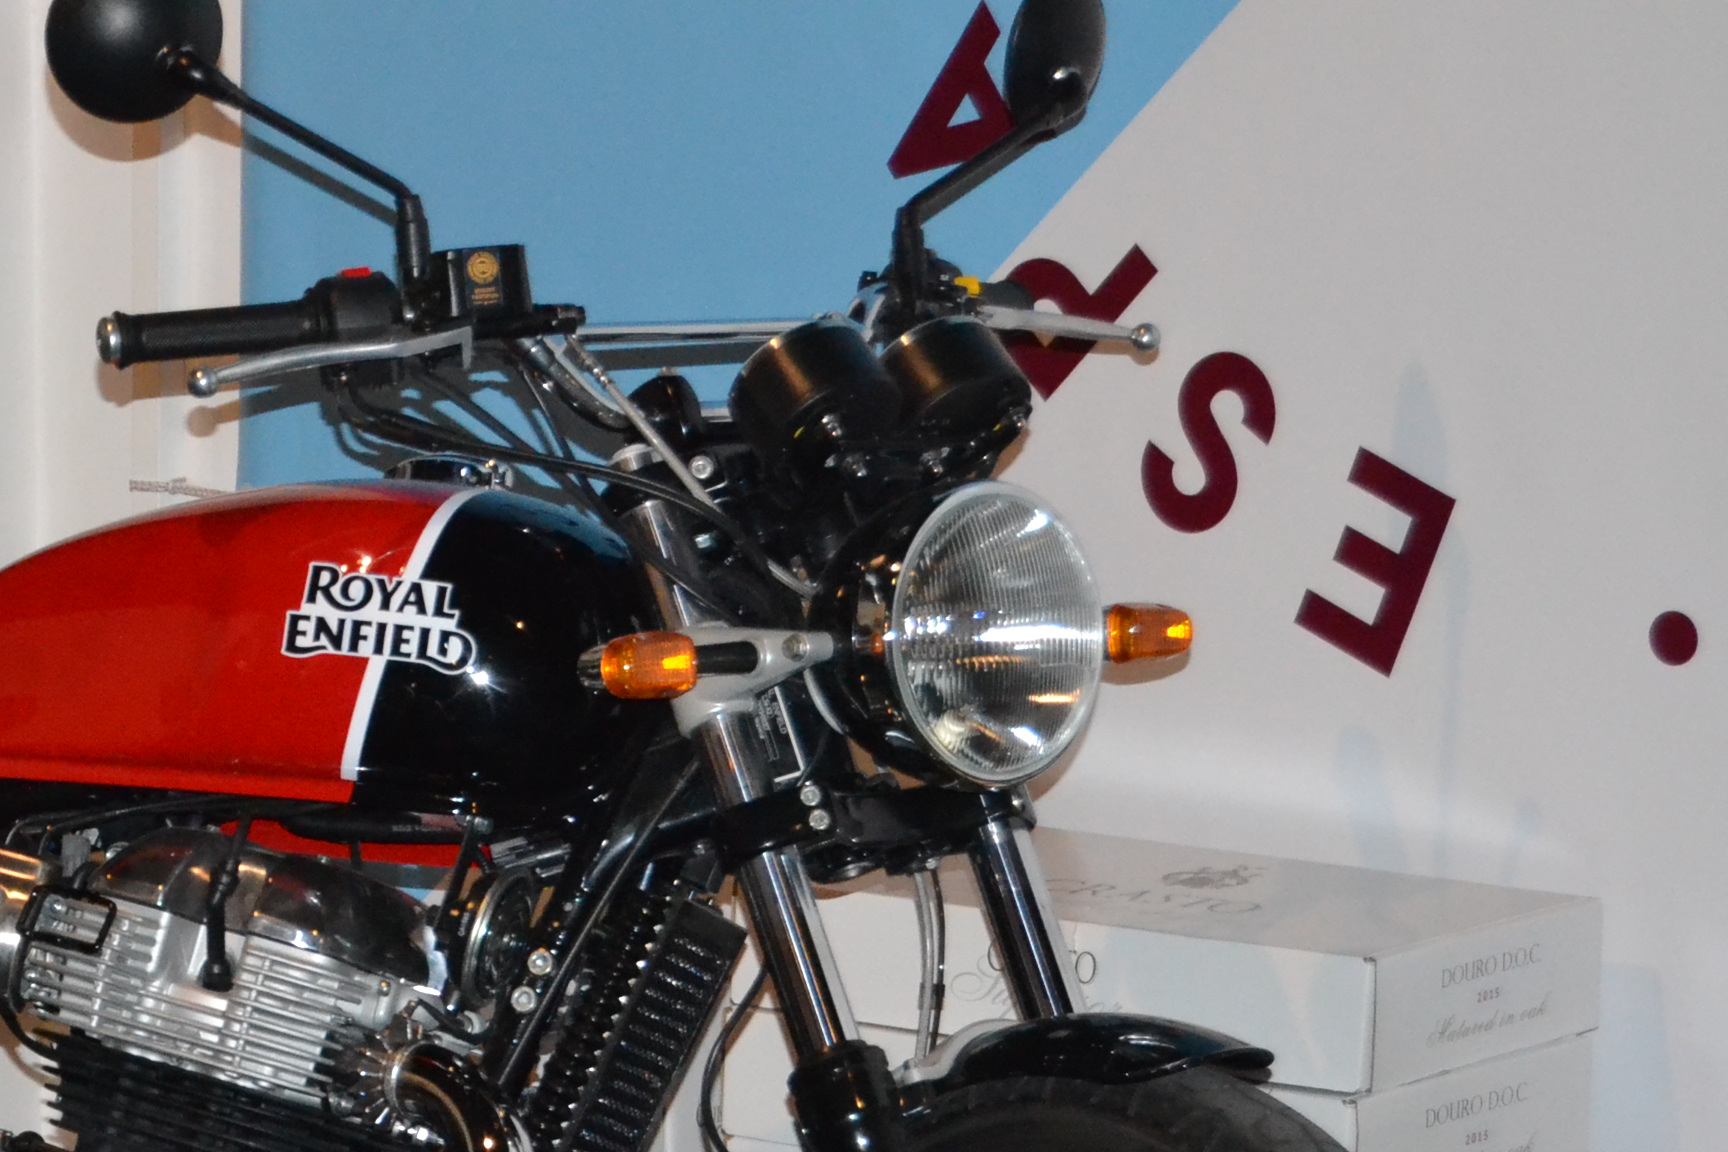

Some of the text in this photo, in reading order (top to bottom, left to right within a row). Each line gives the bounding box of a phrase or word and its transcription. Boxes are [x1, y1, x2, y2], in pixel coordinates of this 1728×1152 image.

[305, 565, 456, 619] ROYAL
[284, 614, 472, 670] ENFIELD
[1441, 954, 1498, 988] DOURO
[1477, 987, 1500, 1003] 2015
[1426, 991, 1552, 1048] Matured in oak
[1425, 1094, 1483, 1128] DOURO
[1465, 1130, 1489, 1146] 2015
